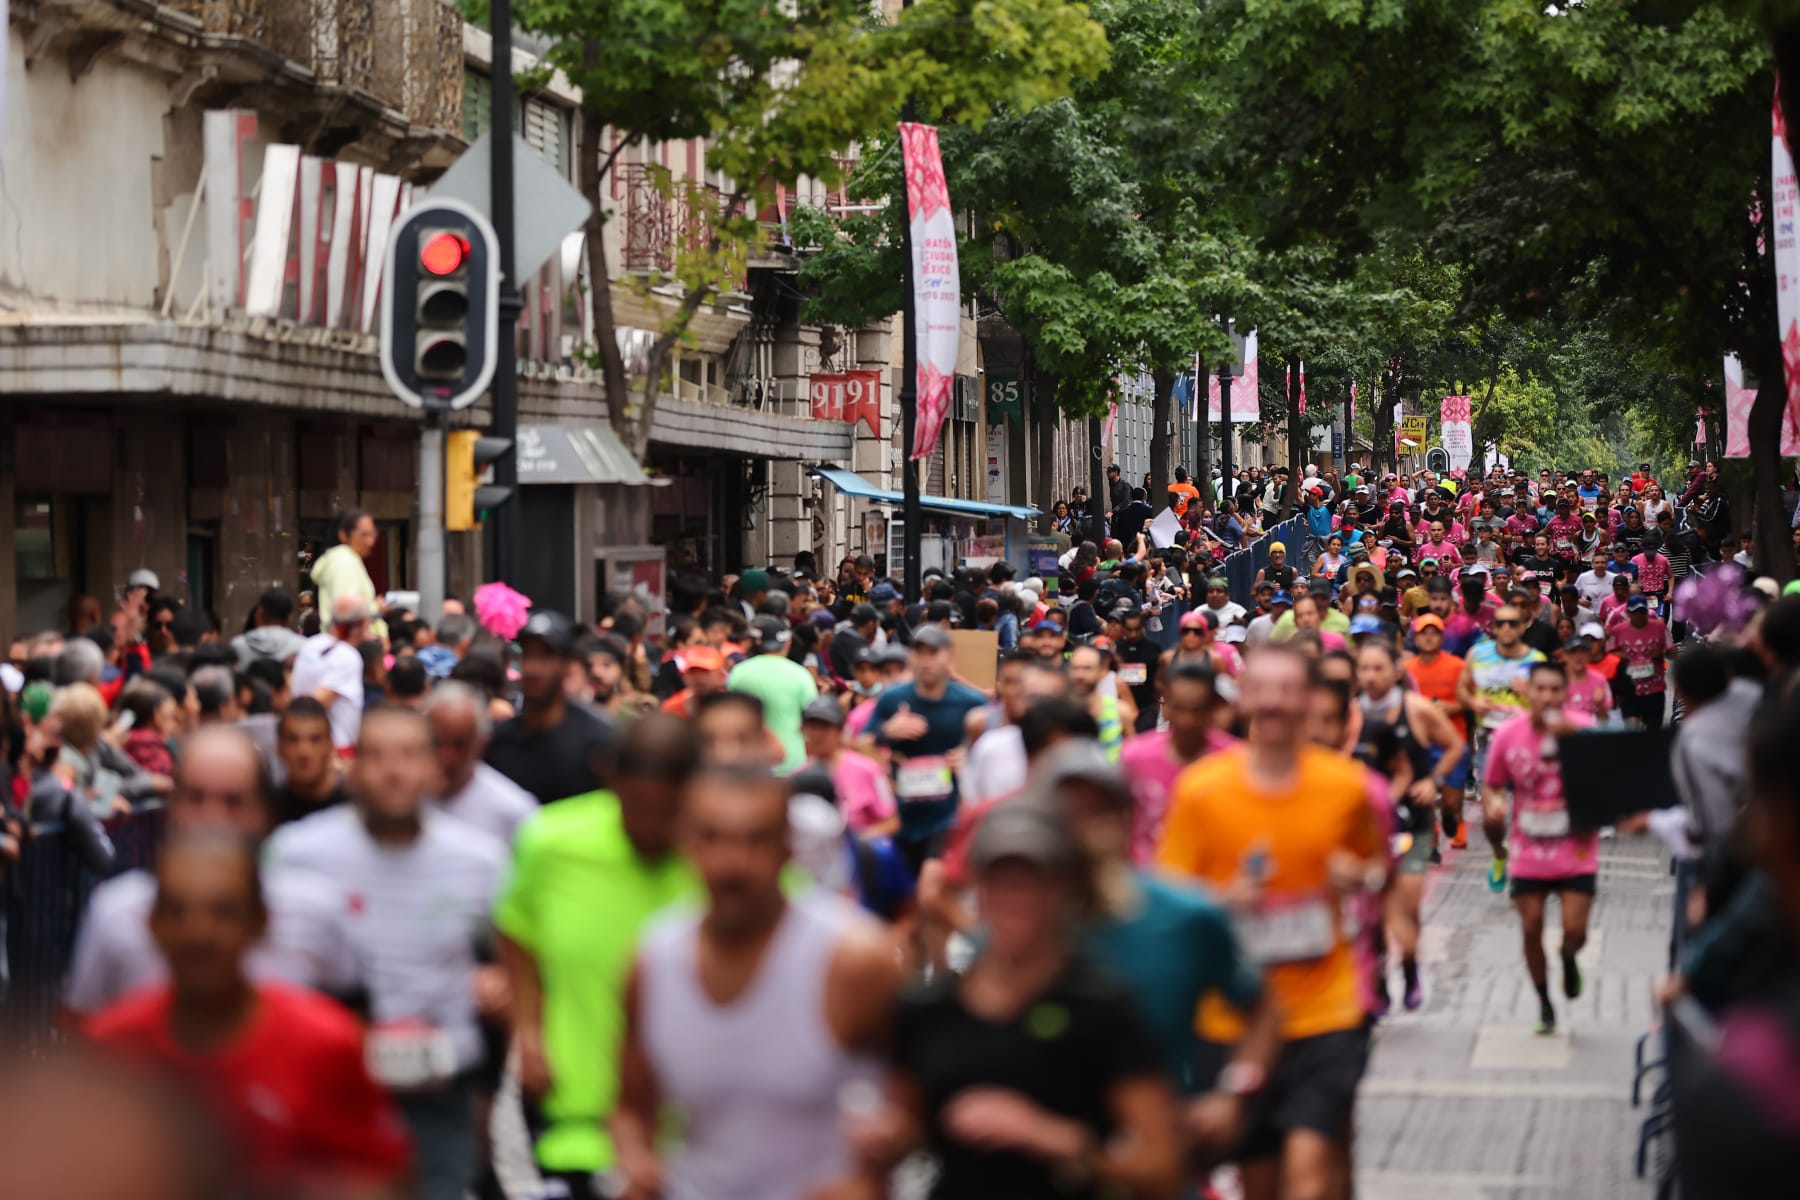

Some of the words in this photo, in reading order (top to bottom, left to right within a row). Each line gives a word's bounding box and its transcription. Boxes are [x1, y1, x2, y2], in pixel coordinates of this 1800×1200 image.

[813, 382, 843, 409] 91
[847, 380, 879, 405] 91
[991, 381, 1019, 403] 85
